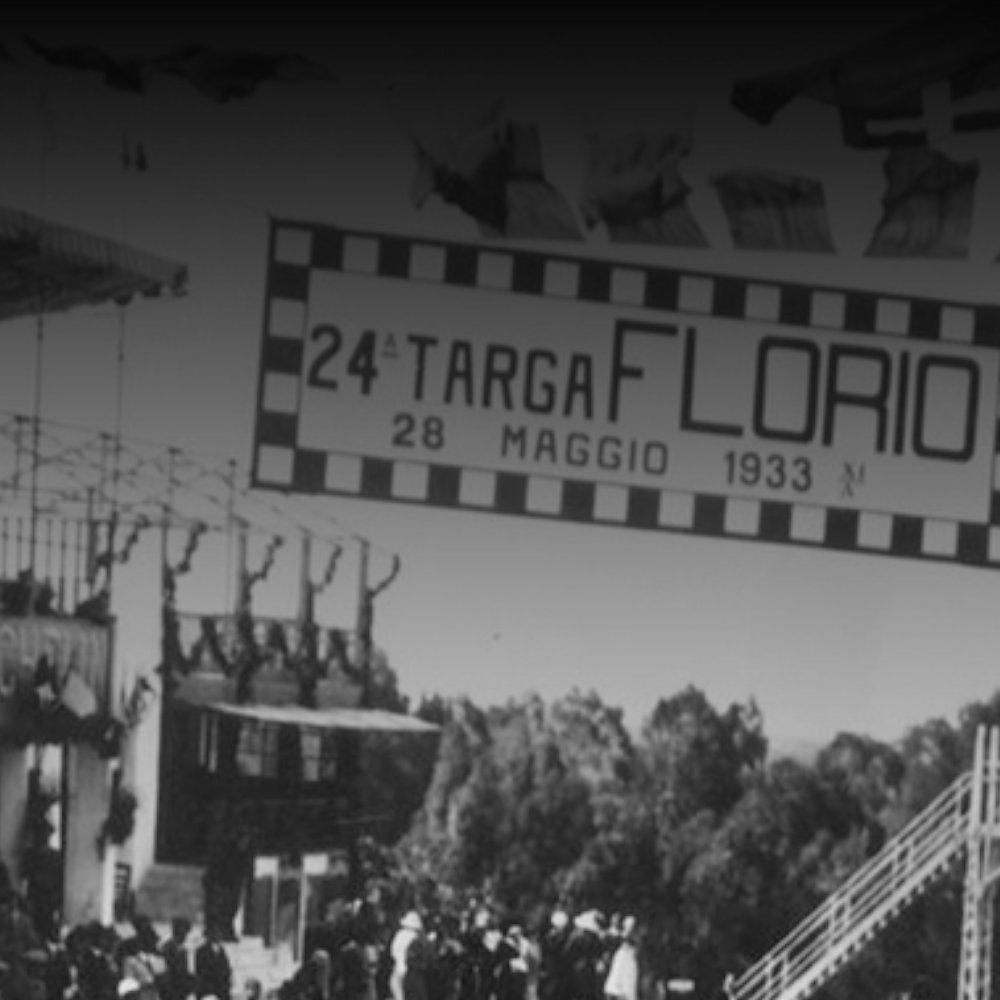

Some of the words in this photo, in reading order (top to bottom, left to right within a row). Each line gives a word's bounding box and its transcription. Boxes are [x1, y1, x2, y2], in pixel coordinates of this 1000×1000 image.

[406, 334, 595, 419] TARGA
[609, 319, 981, 463] FLORIO
[391, 413, 446, 451] 28
[501, 424, 668, 476] MAGGIO
[723, 450, 813, 495] 1933
